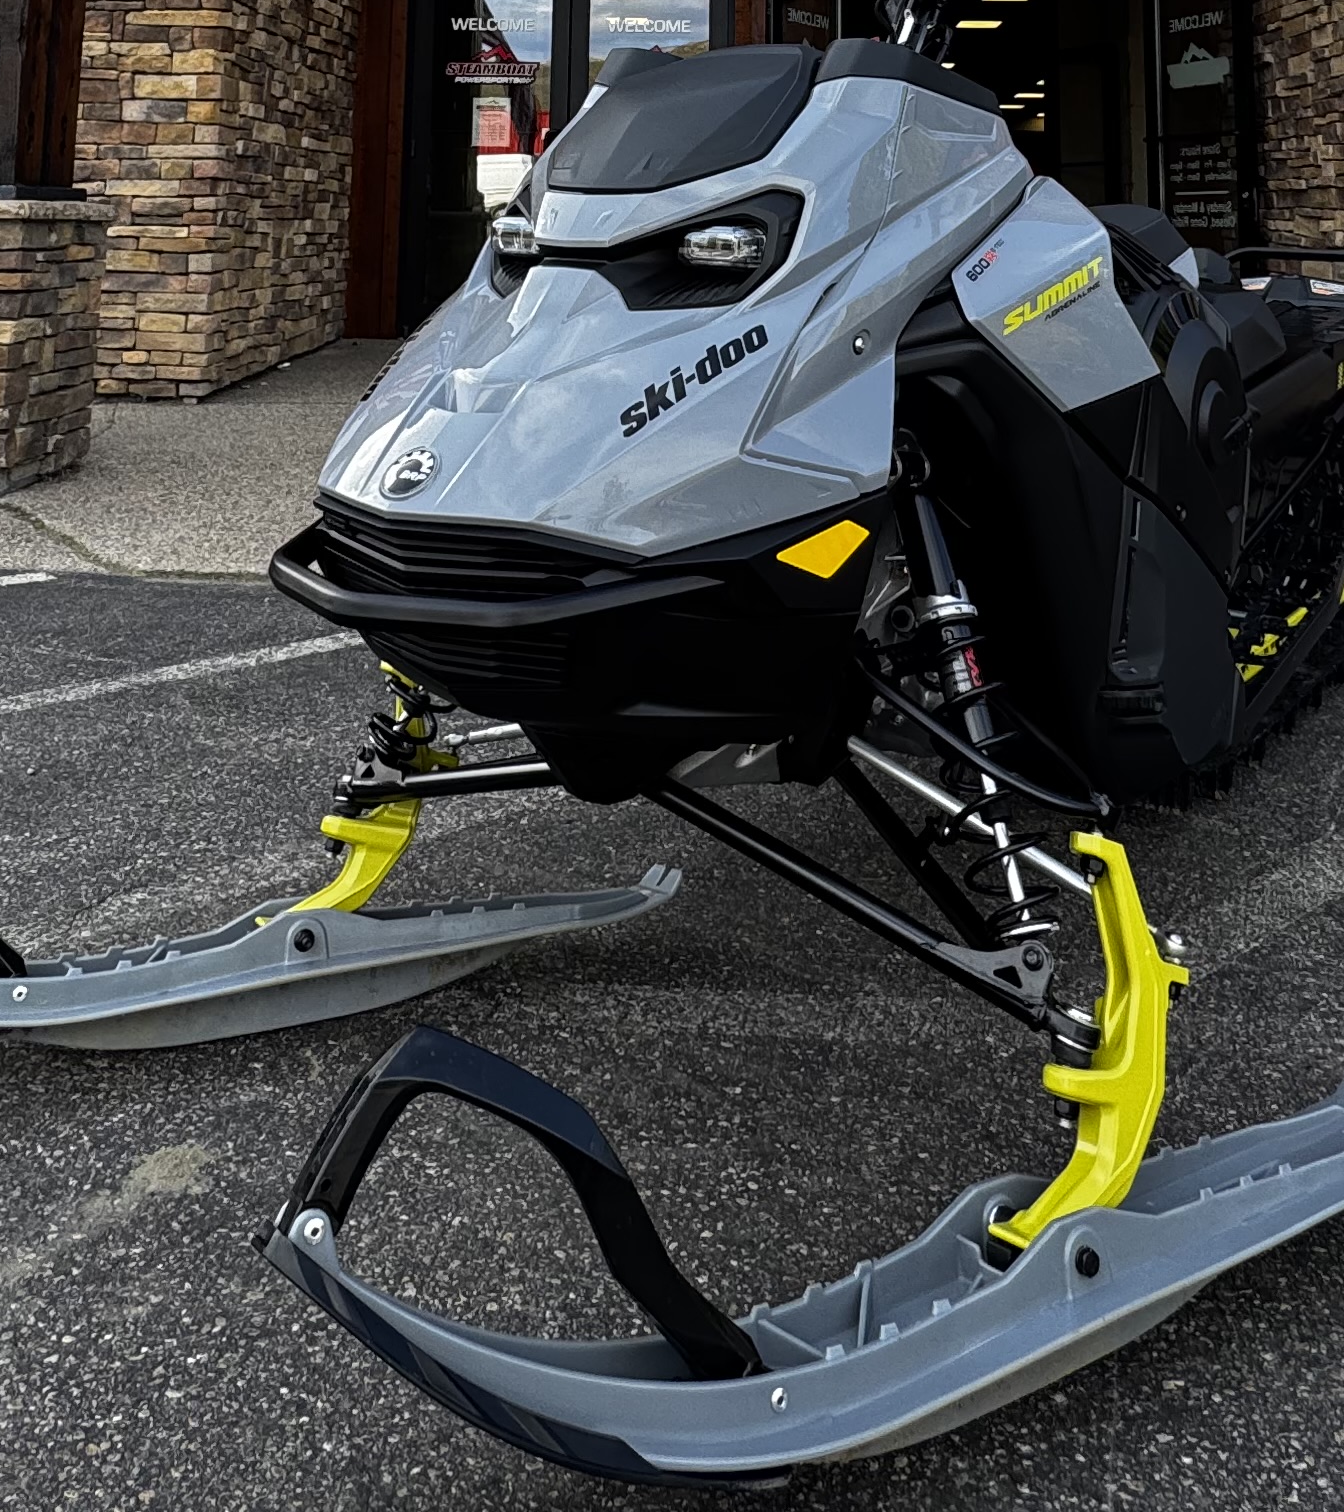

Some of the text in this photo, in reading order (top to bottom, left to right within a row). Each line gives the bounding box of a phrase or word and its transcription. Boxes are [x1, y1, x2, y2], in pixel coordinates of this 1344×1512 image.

[450, 17, 536, 32] WELCOME
[608, 19, 691, 33] WELCOME
[446, 62, 537, 76] STEAMBOAT
[1003, 255, 1103, 336] SUMMIT
[1044, 280, 1100, 321] ADRENALINE
[620, 324, 768, 437] ski-doo
